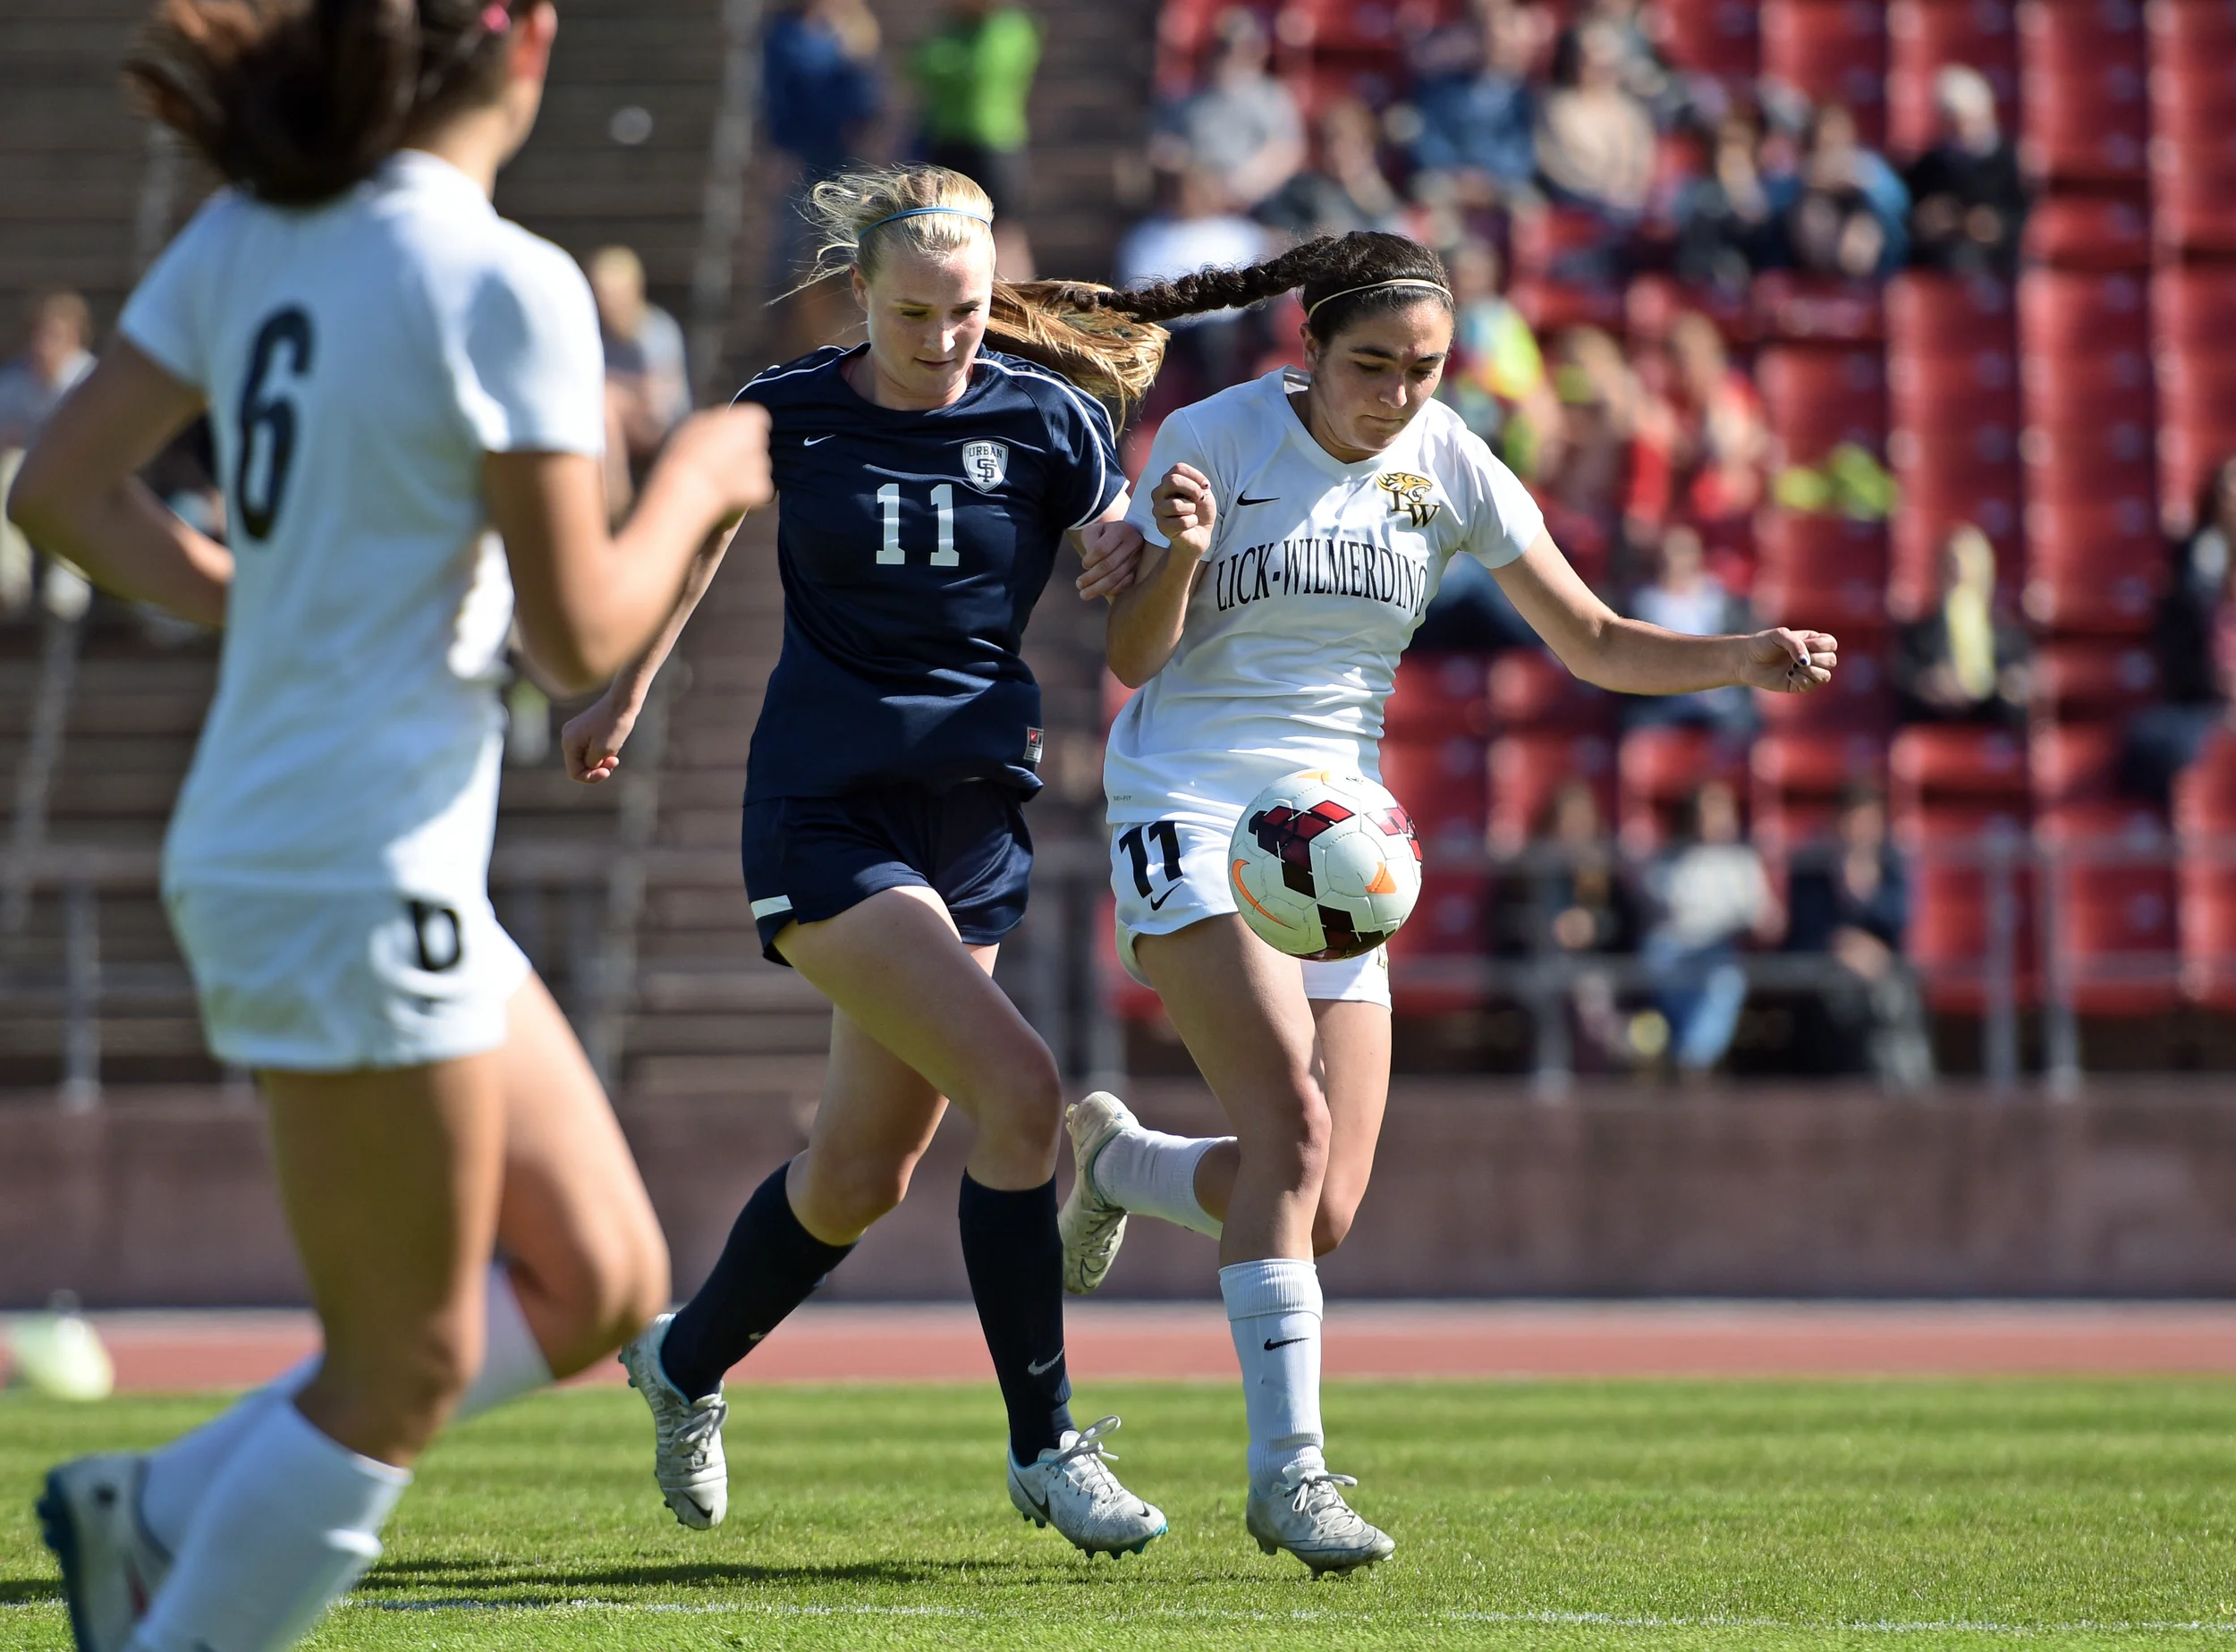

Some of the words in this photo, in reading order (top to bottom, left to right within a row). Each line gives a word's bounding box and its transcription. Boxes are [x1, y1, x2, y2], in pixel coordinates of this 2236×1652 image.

[235, 304, 313, 542] 6
[969, 446, 1004, 459] URBAN
[876, 483, 960, 567] 11
[1391, 489, 1441, 529] LW
[1118, 820, 1185, 899] 11
